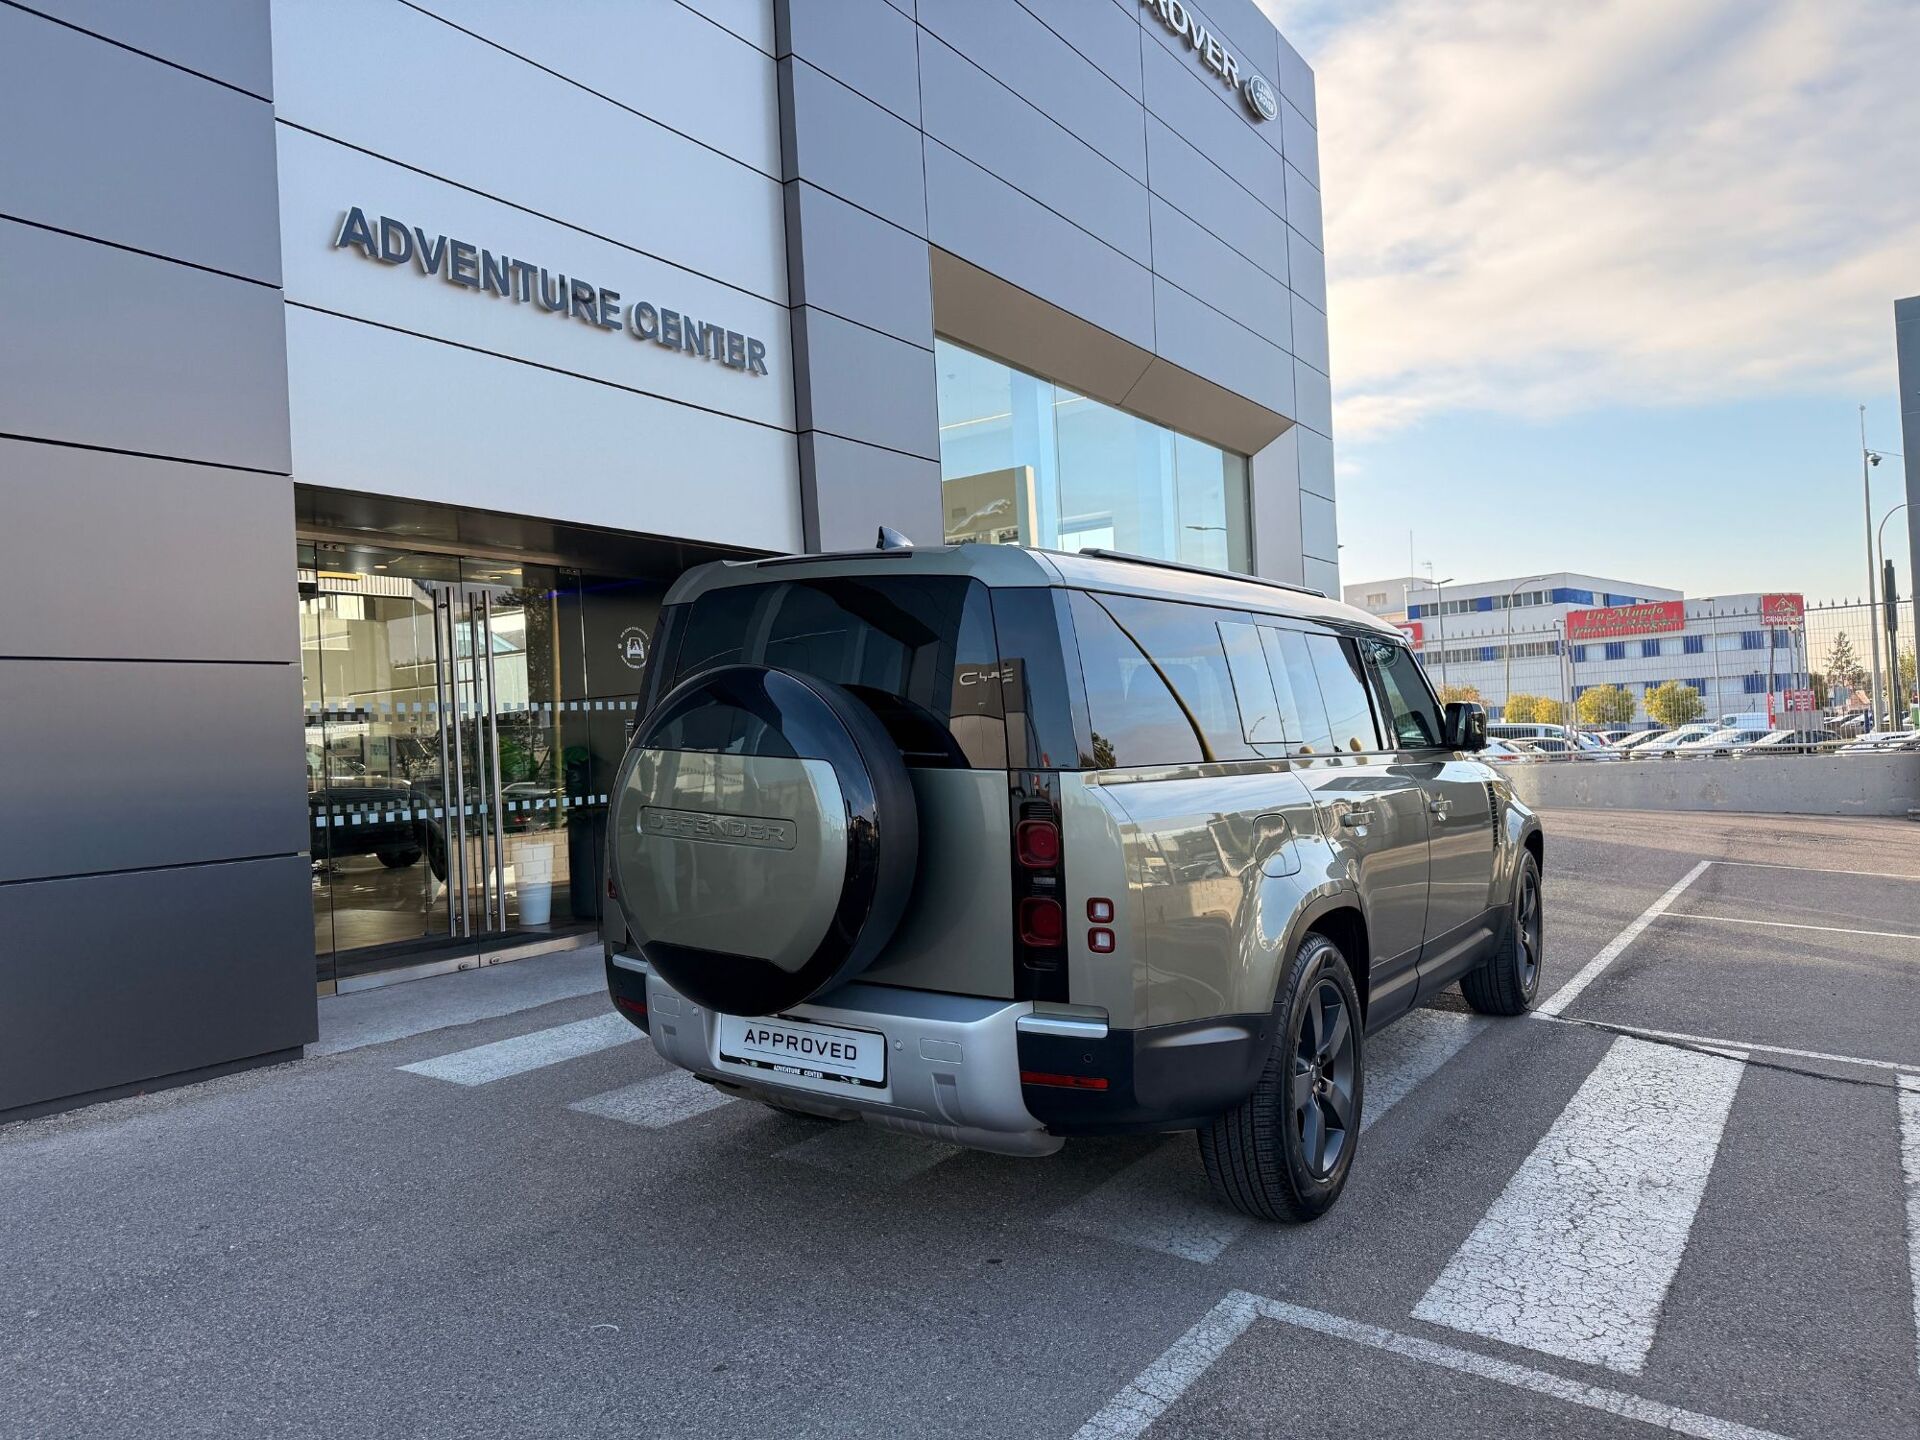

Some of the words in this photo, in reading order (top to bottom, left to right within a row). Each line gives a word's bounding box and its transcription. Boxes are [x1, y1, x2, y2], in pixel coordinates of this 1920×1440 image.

[335, 206, 623, 331] ADVENTURE
[630, 301, 768, 375] CENTER
[1586, 611, 1604, 621] Un
[1607, 604, 1664, 620] Mundo
[648, 812, 785, 842] DEFENDER
[744, 1028, 857, 1060] APPROVED
[803, 1070, 823, 1079] CENTER
